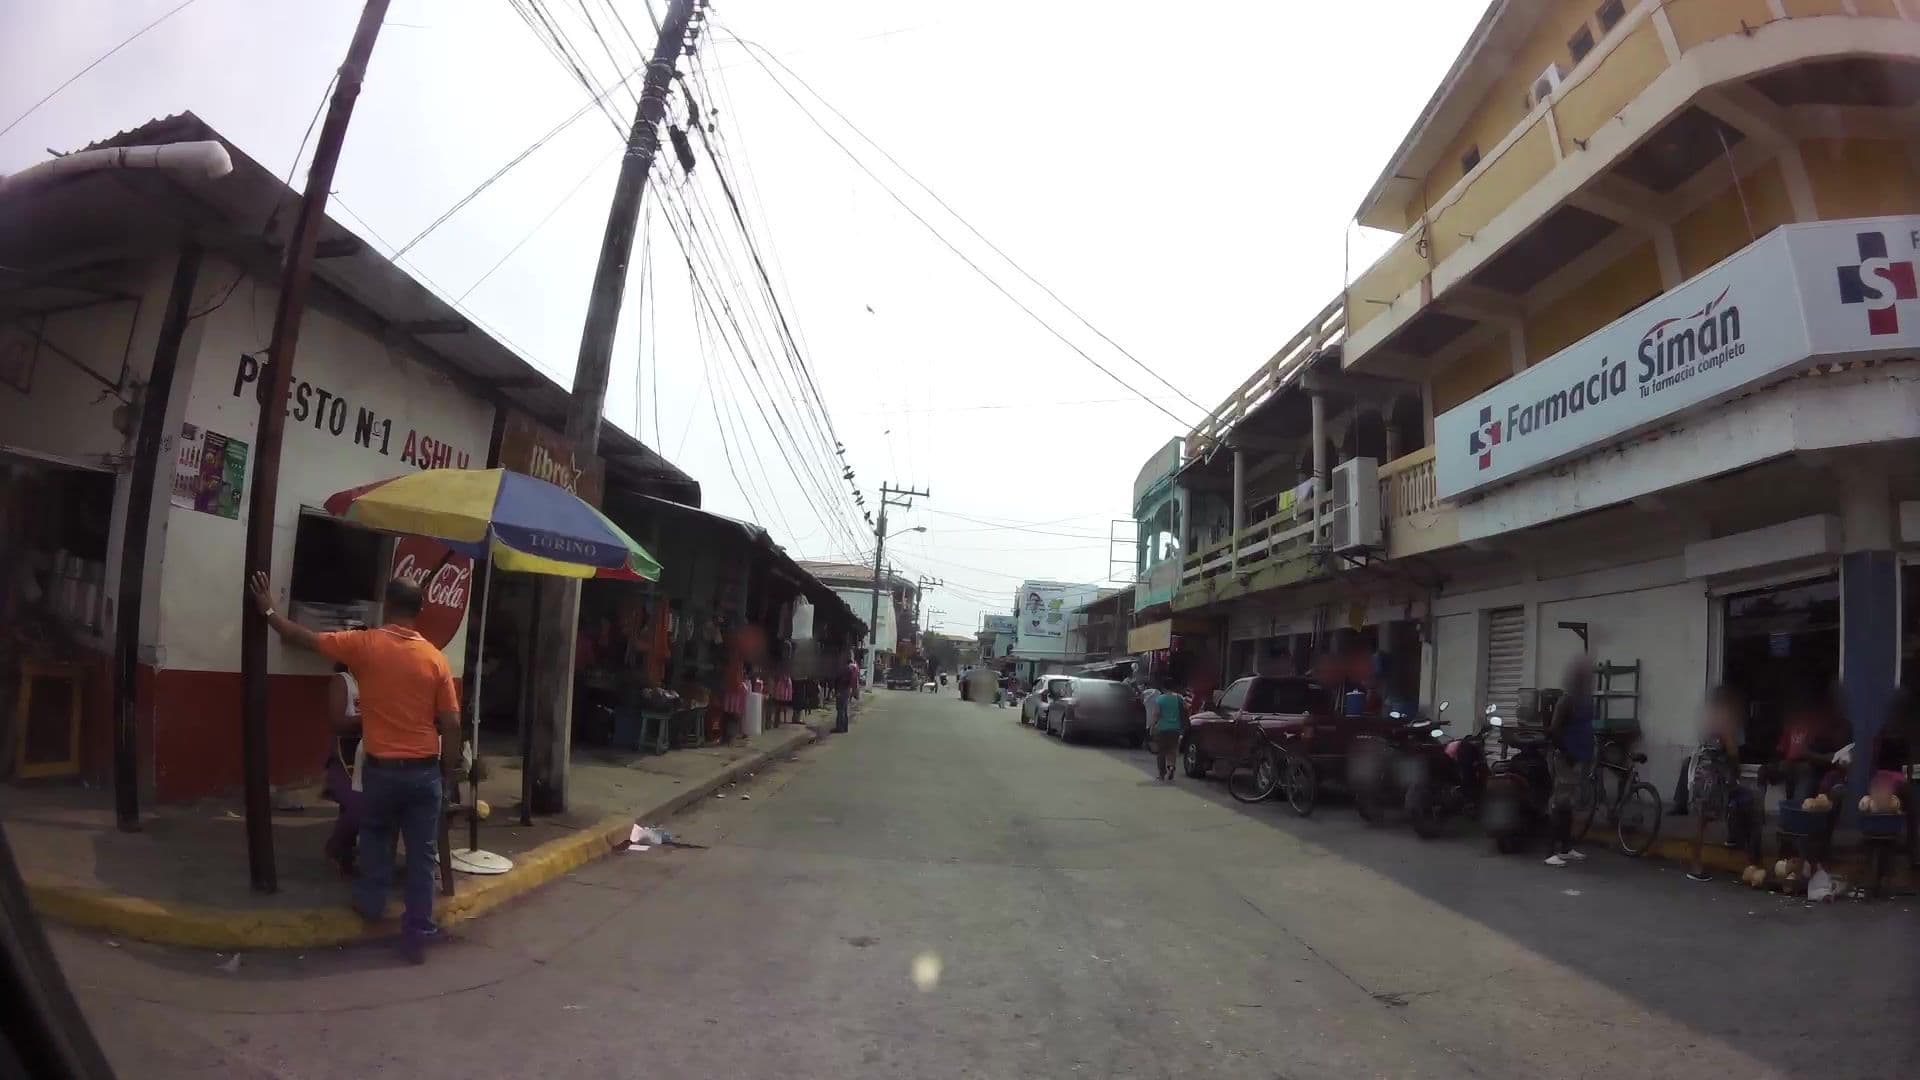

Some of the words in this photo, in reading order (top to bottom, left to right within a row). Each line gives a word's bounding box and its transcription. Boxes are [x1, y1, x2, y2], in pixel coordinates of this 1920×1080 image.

[1507, 356, 1627, 442] Farmacia
[1638, 300, 1740, 384] Simán
[1640, 385, 1650, 399] Tu
[1653, 366, 1695, 394] farmacia
[1698, 343, 1745, 373] completa
[530, 534, 597, 557] TORINO
